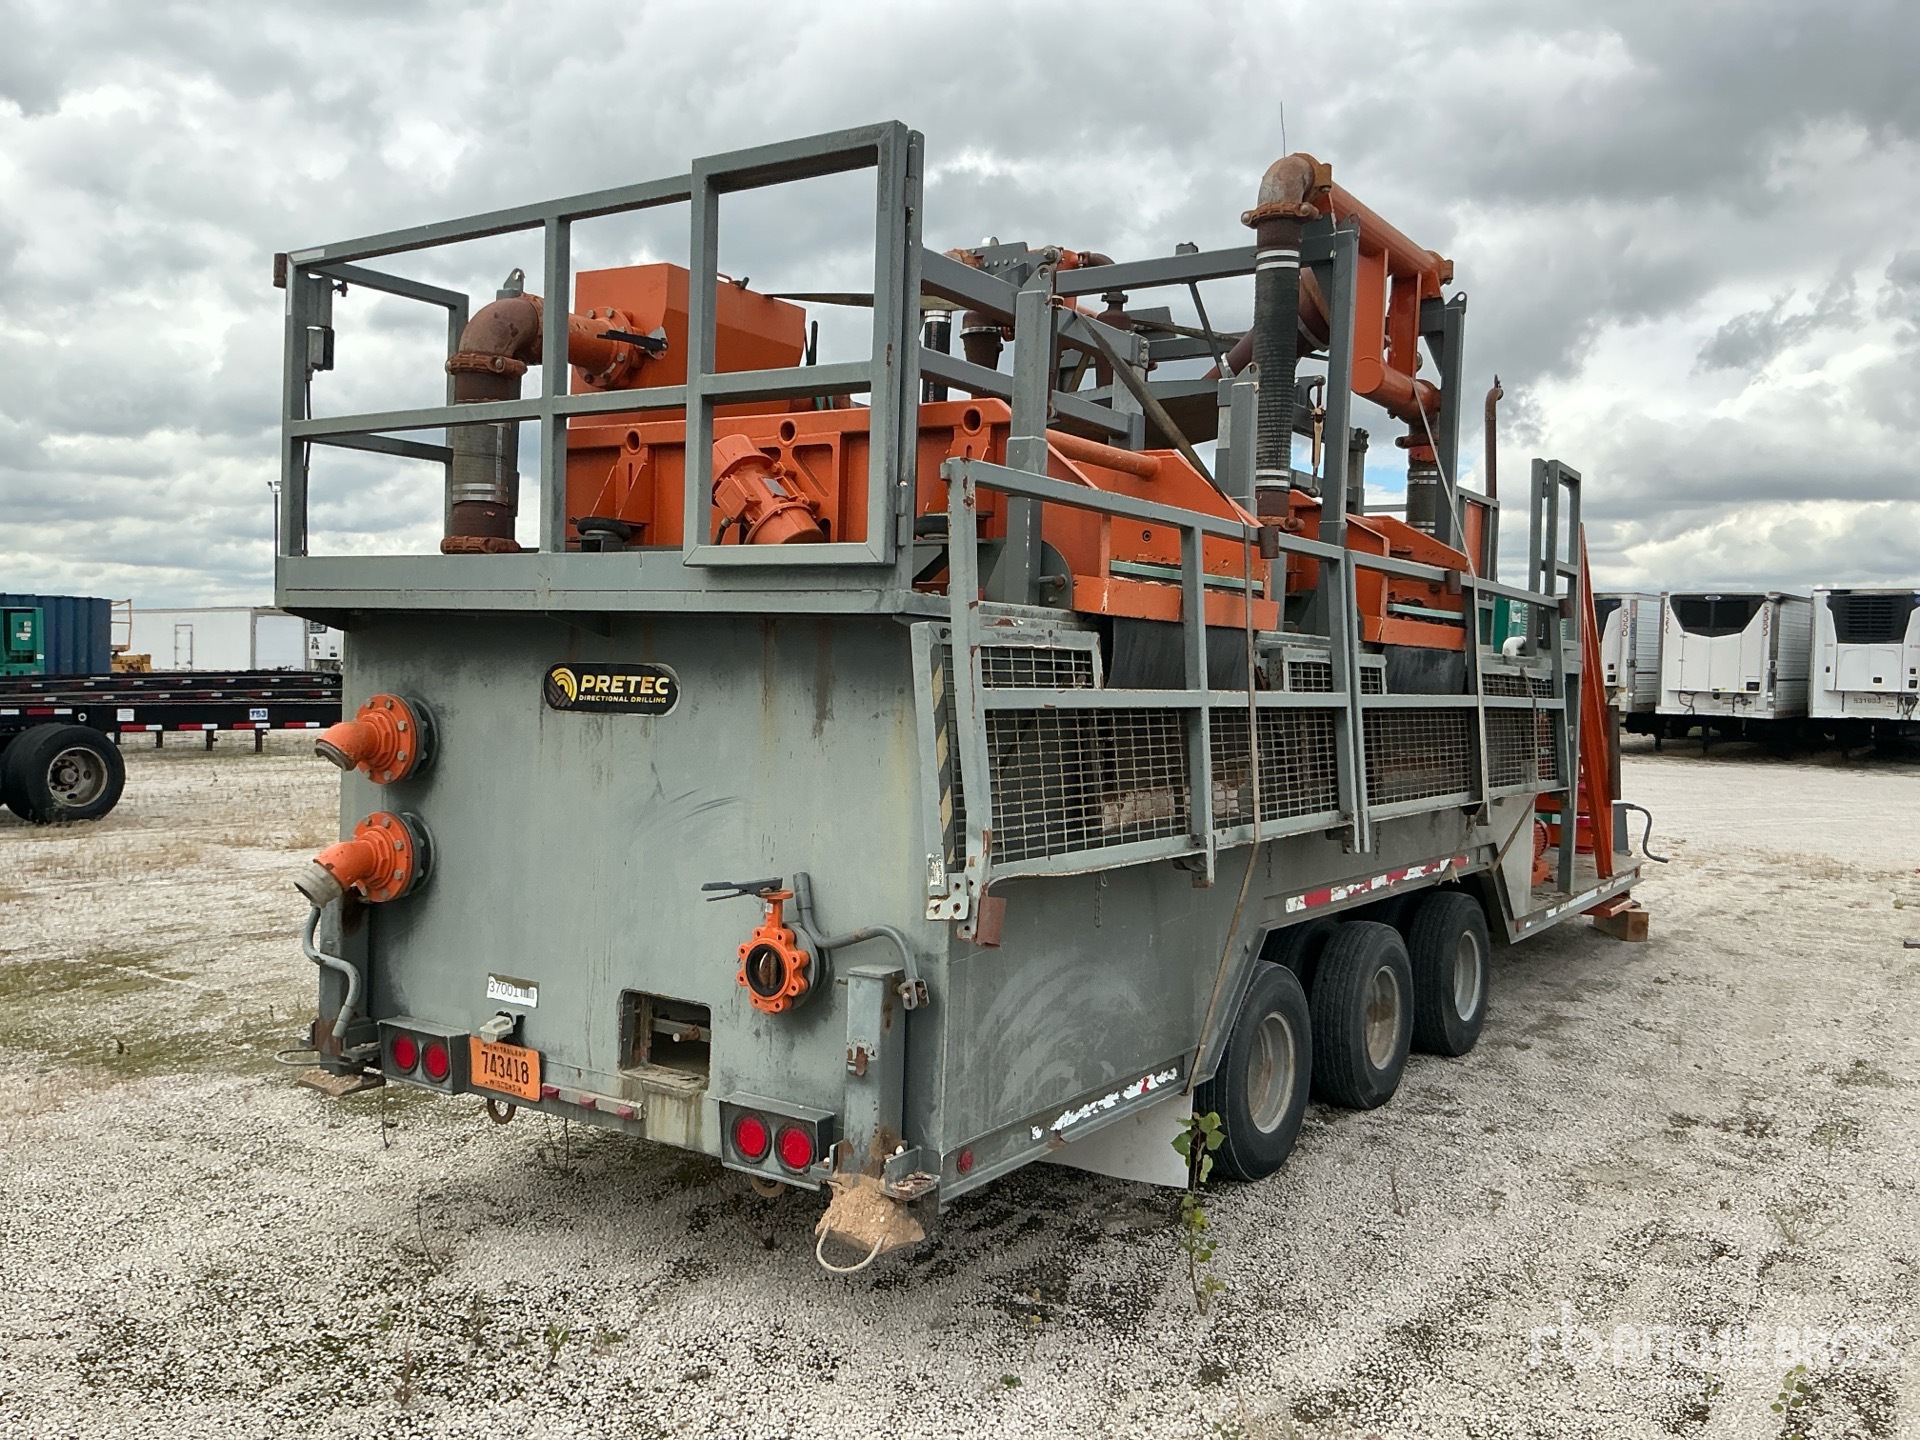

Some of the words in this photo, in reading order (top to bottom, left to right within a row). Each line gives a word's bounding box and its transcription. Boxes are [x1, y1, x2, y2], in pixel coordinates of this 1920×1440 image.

[580, 674, 670, 695] PRETEC
[579, 694, 628, 703] DIRECTIONAL
[630, 696, 667, 704] DRILLING
[489, 980, 519, 998] 37001
[481, 1050, 529, 1085] 743418
